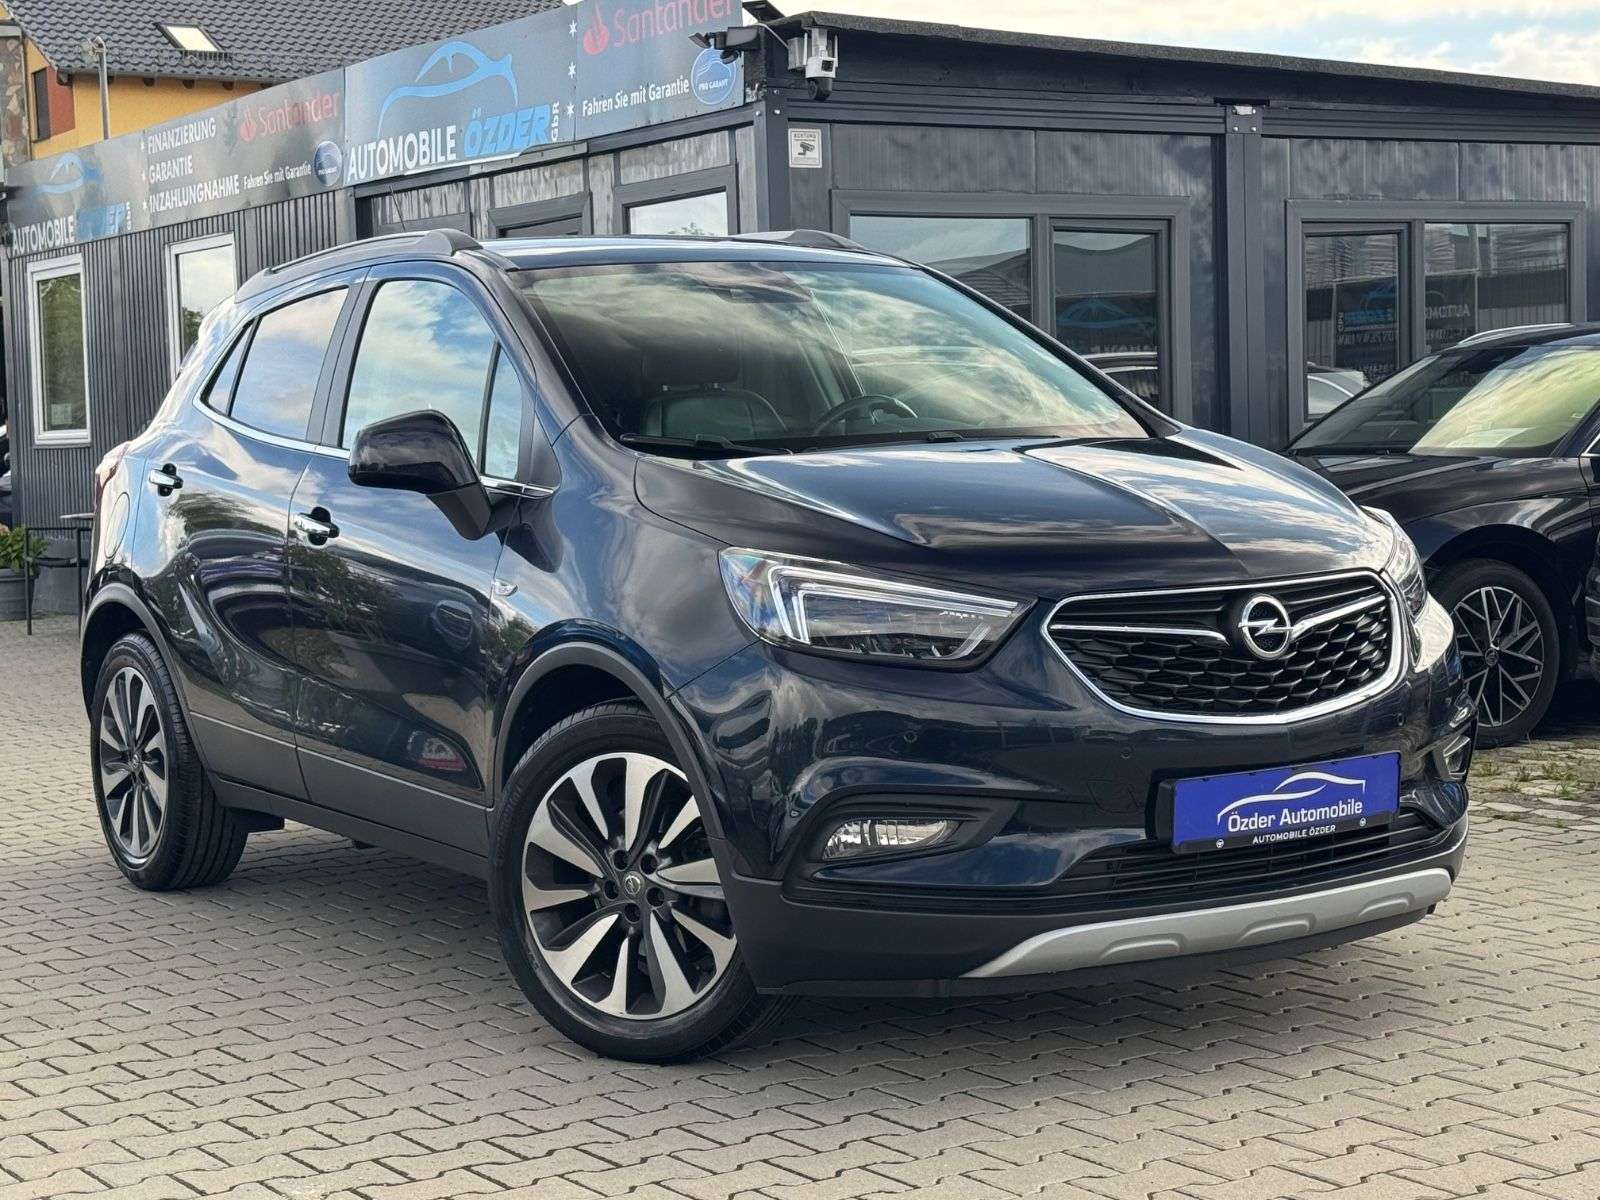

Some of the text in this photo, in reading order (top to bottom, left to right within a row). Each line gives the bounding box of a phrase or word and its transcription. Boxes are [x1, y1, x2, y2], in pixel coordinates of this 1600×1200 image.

[613, 0, 732, 48] Santander
[258, 91, 339, 137] Santander
[582, 75, 690, 116] Fahren Sie mit Garantie
[147, 117, 217, 154] FINANZIERUNG
[551, 101, 560, 142] GbR
[346, 106, 551, 183] AUTOMOBILE ÖZDER
[149, 155, 193, 184] GARANTIE
[243, 174, 264, 190] Fahren
[263, 169, 273, 185] Sie
[274, 167, 286, 182] mit
[285, 161, 312, 180] Garantie
[149, 174, 240, 213] INZAHLUNGNAHME
[12, 215, 75, 256] AUTOMOBILE
[1228, 798, 1363, 832] Özder Automobile
[1252, 824, 1336, 845] AUTOMOBILE ÖZDER
